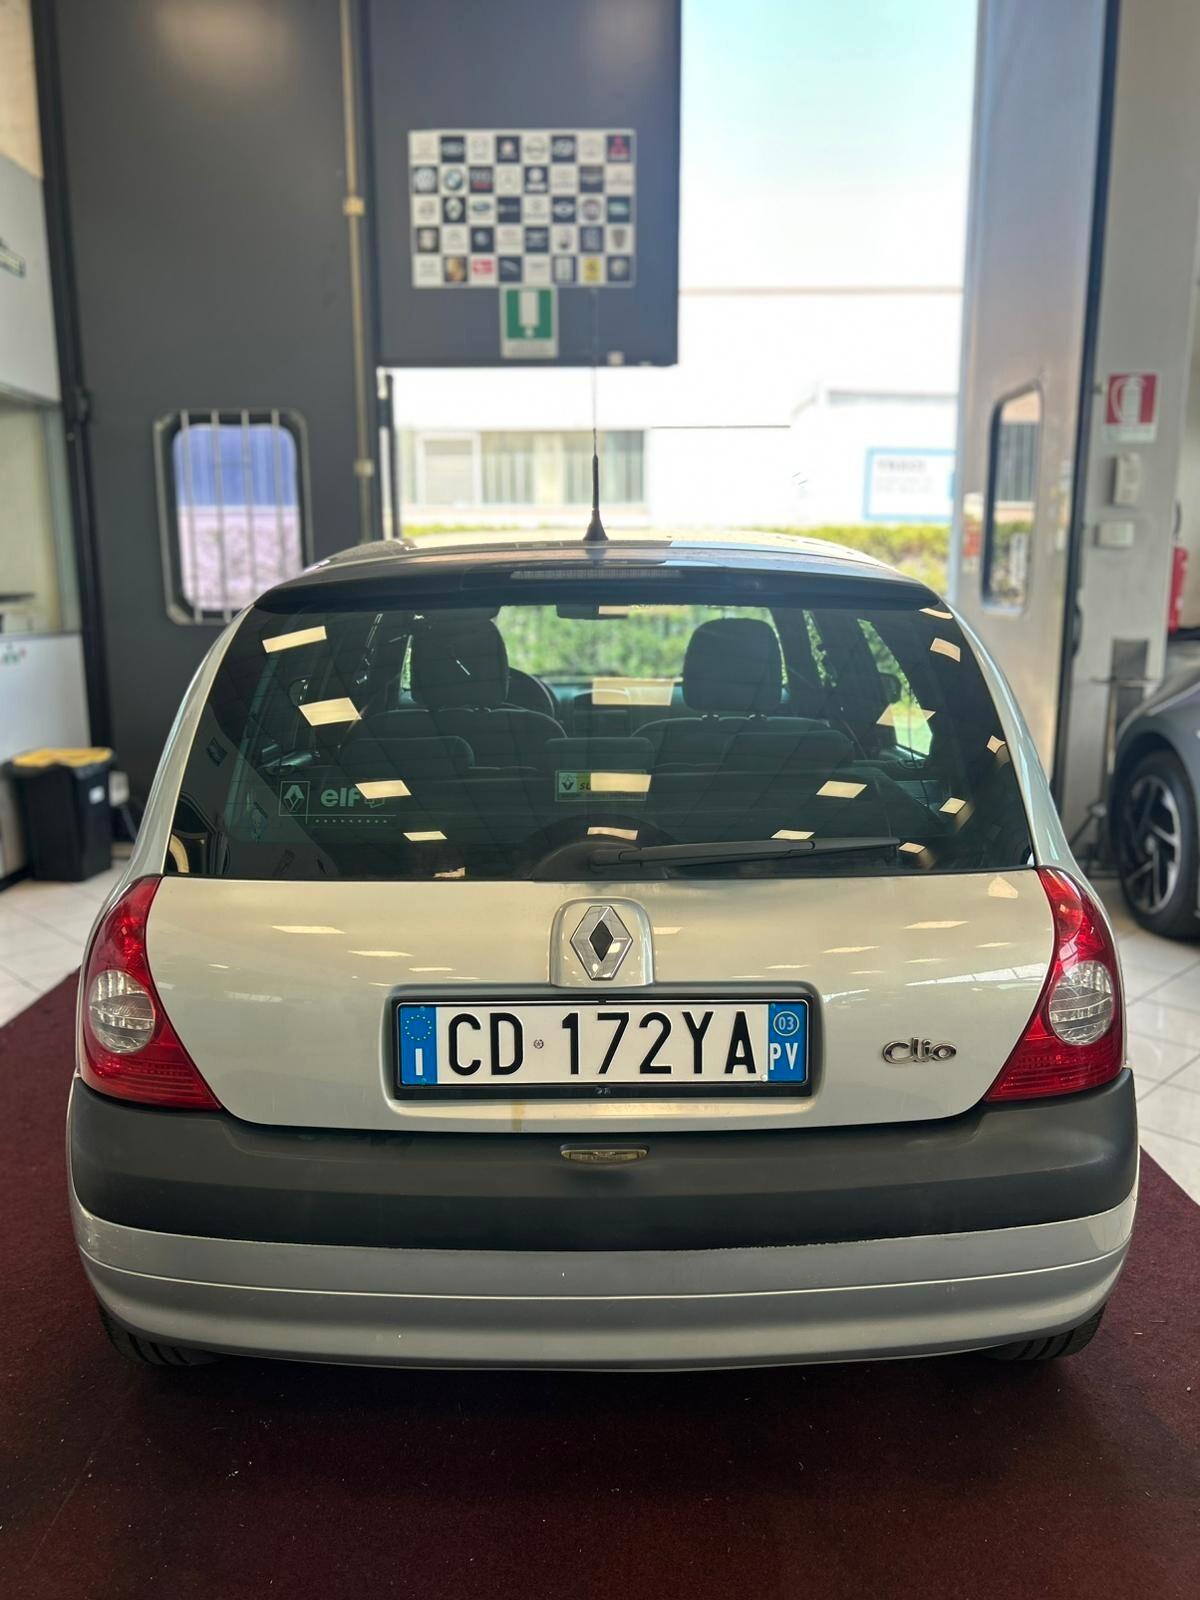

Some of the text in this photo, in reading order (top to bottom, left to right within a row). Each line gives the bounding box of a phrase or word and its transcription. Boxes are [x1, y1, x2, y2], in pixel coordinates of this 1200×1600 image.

[320, 787, 361, 807] elf
[778, 1016, 794, 1030] 03
[448, 1010, 757, 1076] CD 172YA
[769, 1042, 799, 1070] PV
[882, 1037, 957, 1064] Clio
[415, 1048, 423, 1076] I
